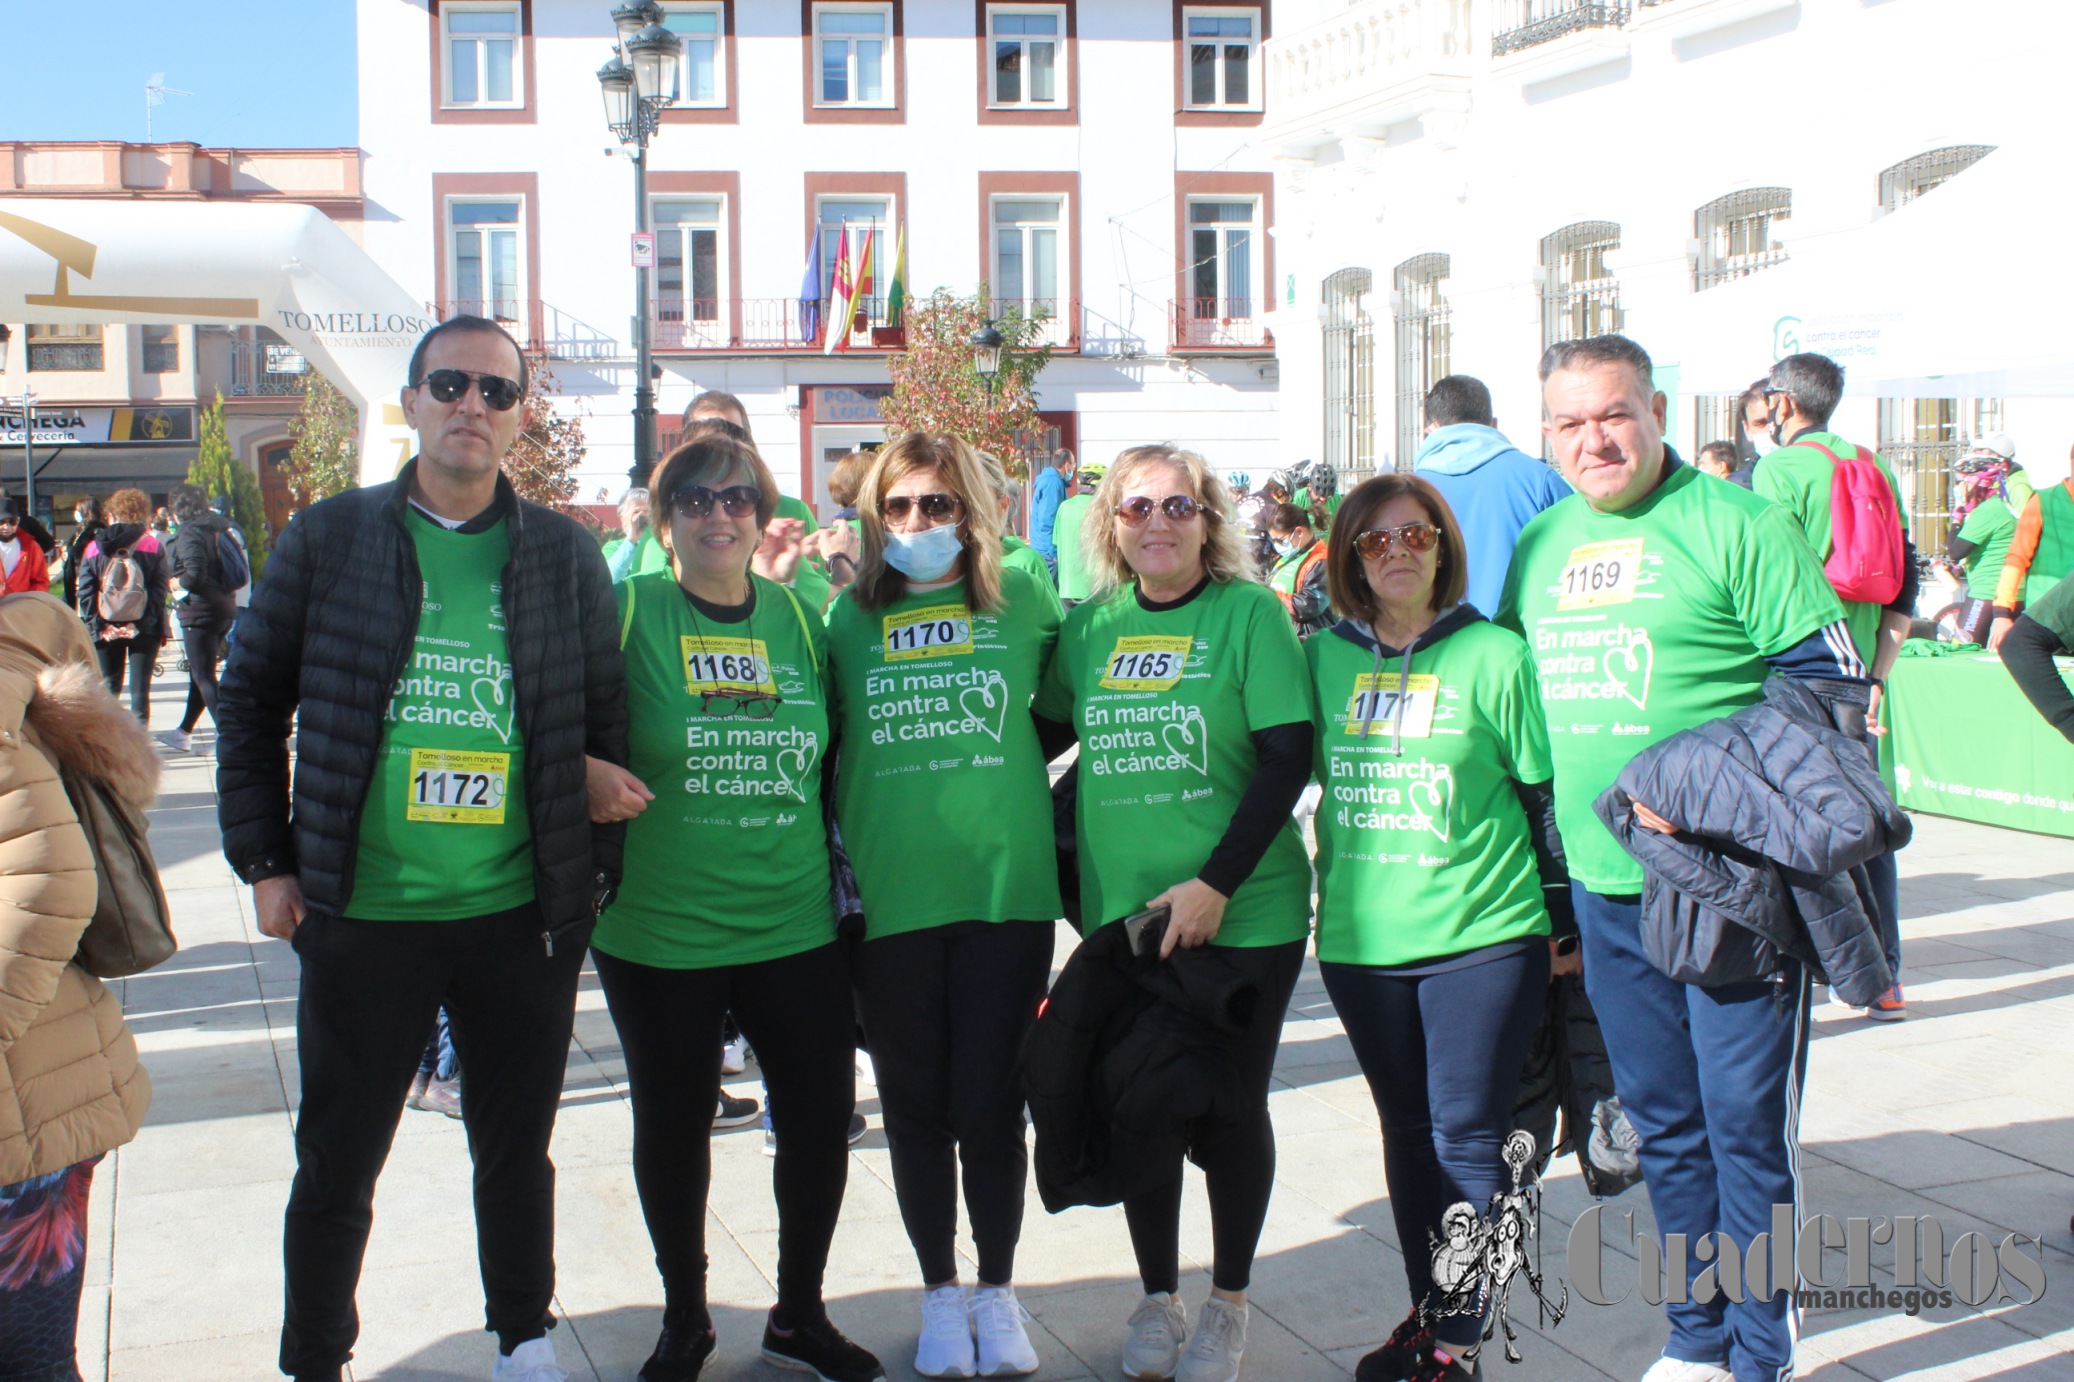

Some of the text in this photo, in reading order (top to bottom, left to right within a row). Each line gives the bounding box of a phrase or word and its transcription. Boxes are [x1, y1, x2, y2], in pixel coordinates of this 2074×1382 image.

[278, 310, 433, 335] TOMELLOSO
[310, 336, 412, 348] AYUNTAMIENTO
[1806, 331, 1836, 343] contra
[1838, 330, 1847, 340] el
[0, 416, 86, 429] CHEGA
[1567, 561, 1621, 594] 1169
[426, 637, 470, 648] TOMELLOSO
[888, 620, 954, 650] 1170
[1535, 622, 1648, 650] En marcha
[416, 652, 512, 680] marcha
[689, 655, 756, 681] 1168
[869, 664, 899, 673] MARCHA
[910, 661, 953, 669] TOMELLOSO
[1112, 653, 1171, 678] 1165
[866, 667, 1002, 697] En marcha
[868, 694, 949, 720] contra
[1123, 692, 1158, 700] TOMELLOSO
[402, 700, 497, 729] cáncer
[1085, 700, 1201, 726] En marcha
[687, 725, 817, 747] En marcha
[871, 717, 986, 745] el cáncer
[1088, 728, 1156, 751] contra
[418, 752, 461, 762] Tomelloso
[473, 756, 504, 764] marcha
[686, 751, 768, 771] contra
[983, 755, 1004, 764] ábea
[1366, 746, 1406, 754] TOMELLO
[1092, 752, 1190, 775] el cáncer
[1331, 756, 1451, 780] En marcha
[415, 771, 489, 806] 1172
[685, 774, 794, 796] el cáncer
[1334, 783, 1401, 804] contra
[1947, 782, 1973, 796] estar
[1975, 786, 2021, 805] contigo
[2022, 791, 2056, 809] donde
[2058, 799, 2074, 813] qu
[1337, 806, 1433, 831] el cáncer
